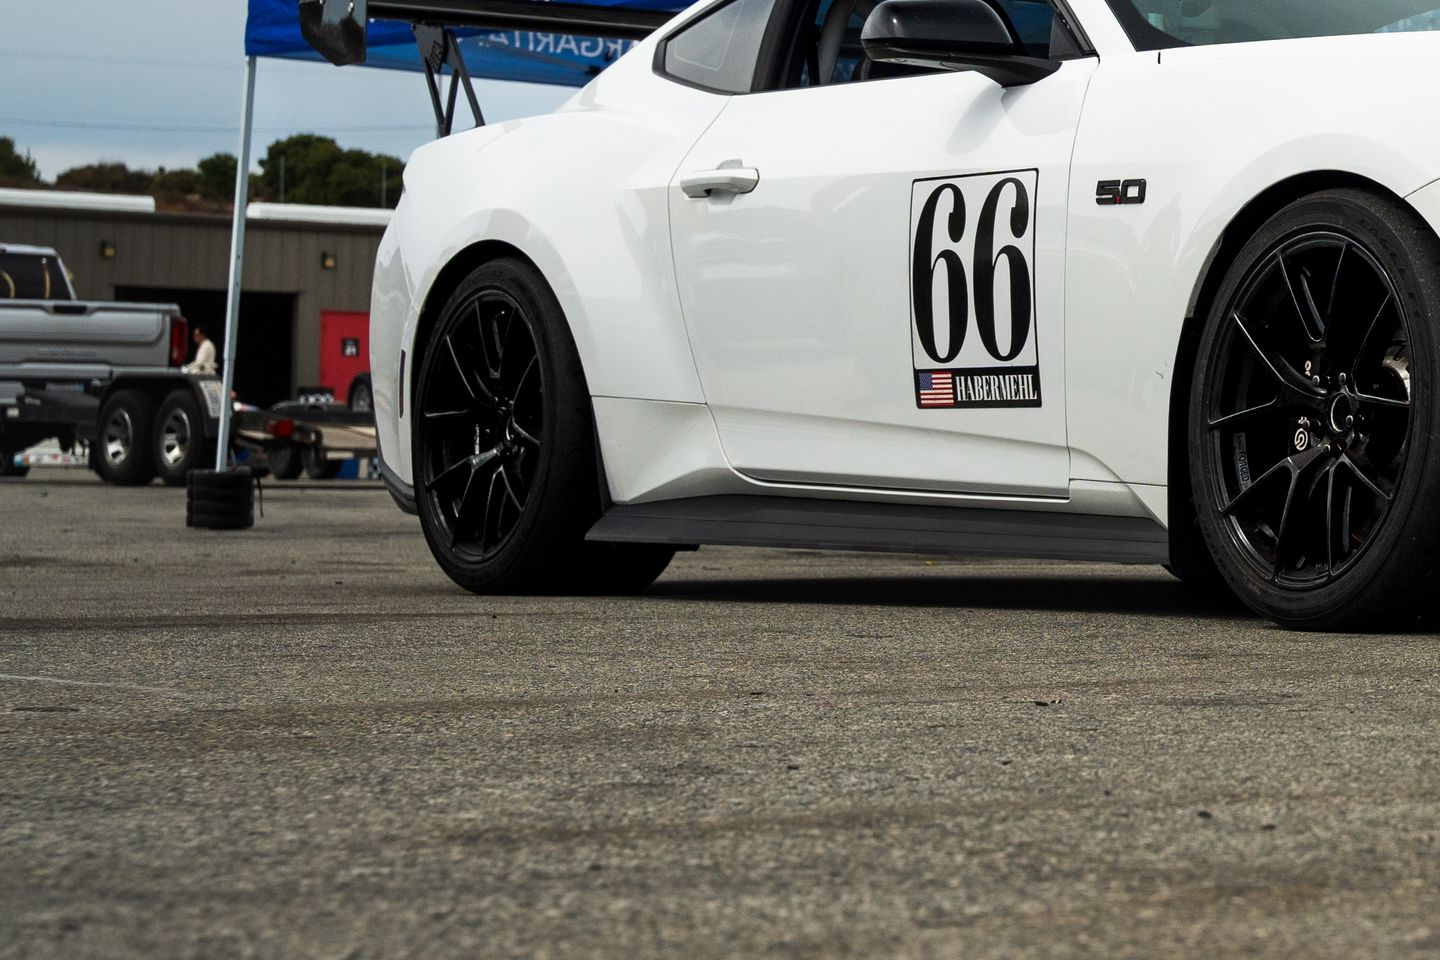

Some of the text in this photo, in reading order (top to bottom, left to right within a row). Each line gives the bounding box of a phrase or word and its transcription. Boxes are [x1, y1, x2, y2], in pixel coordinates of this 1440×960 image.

[1095, 178, 1147, 205] 5.0
[911, 177, 1032, 364] 66
[955, 374, 1038, 402] HABERMEHL
